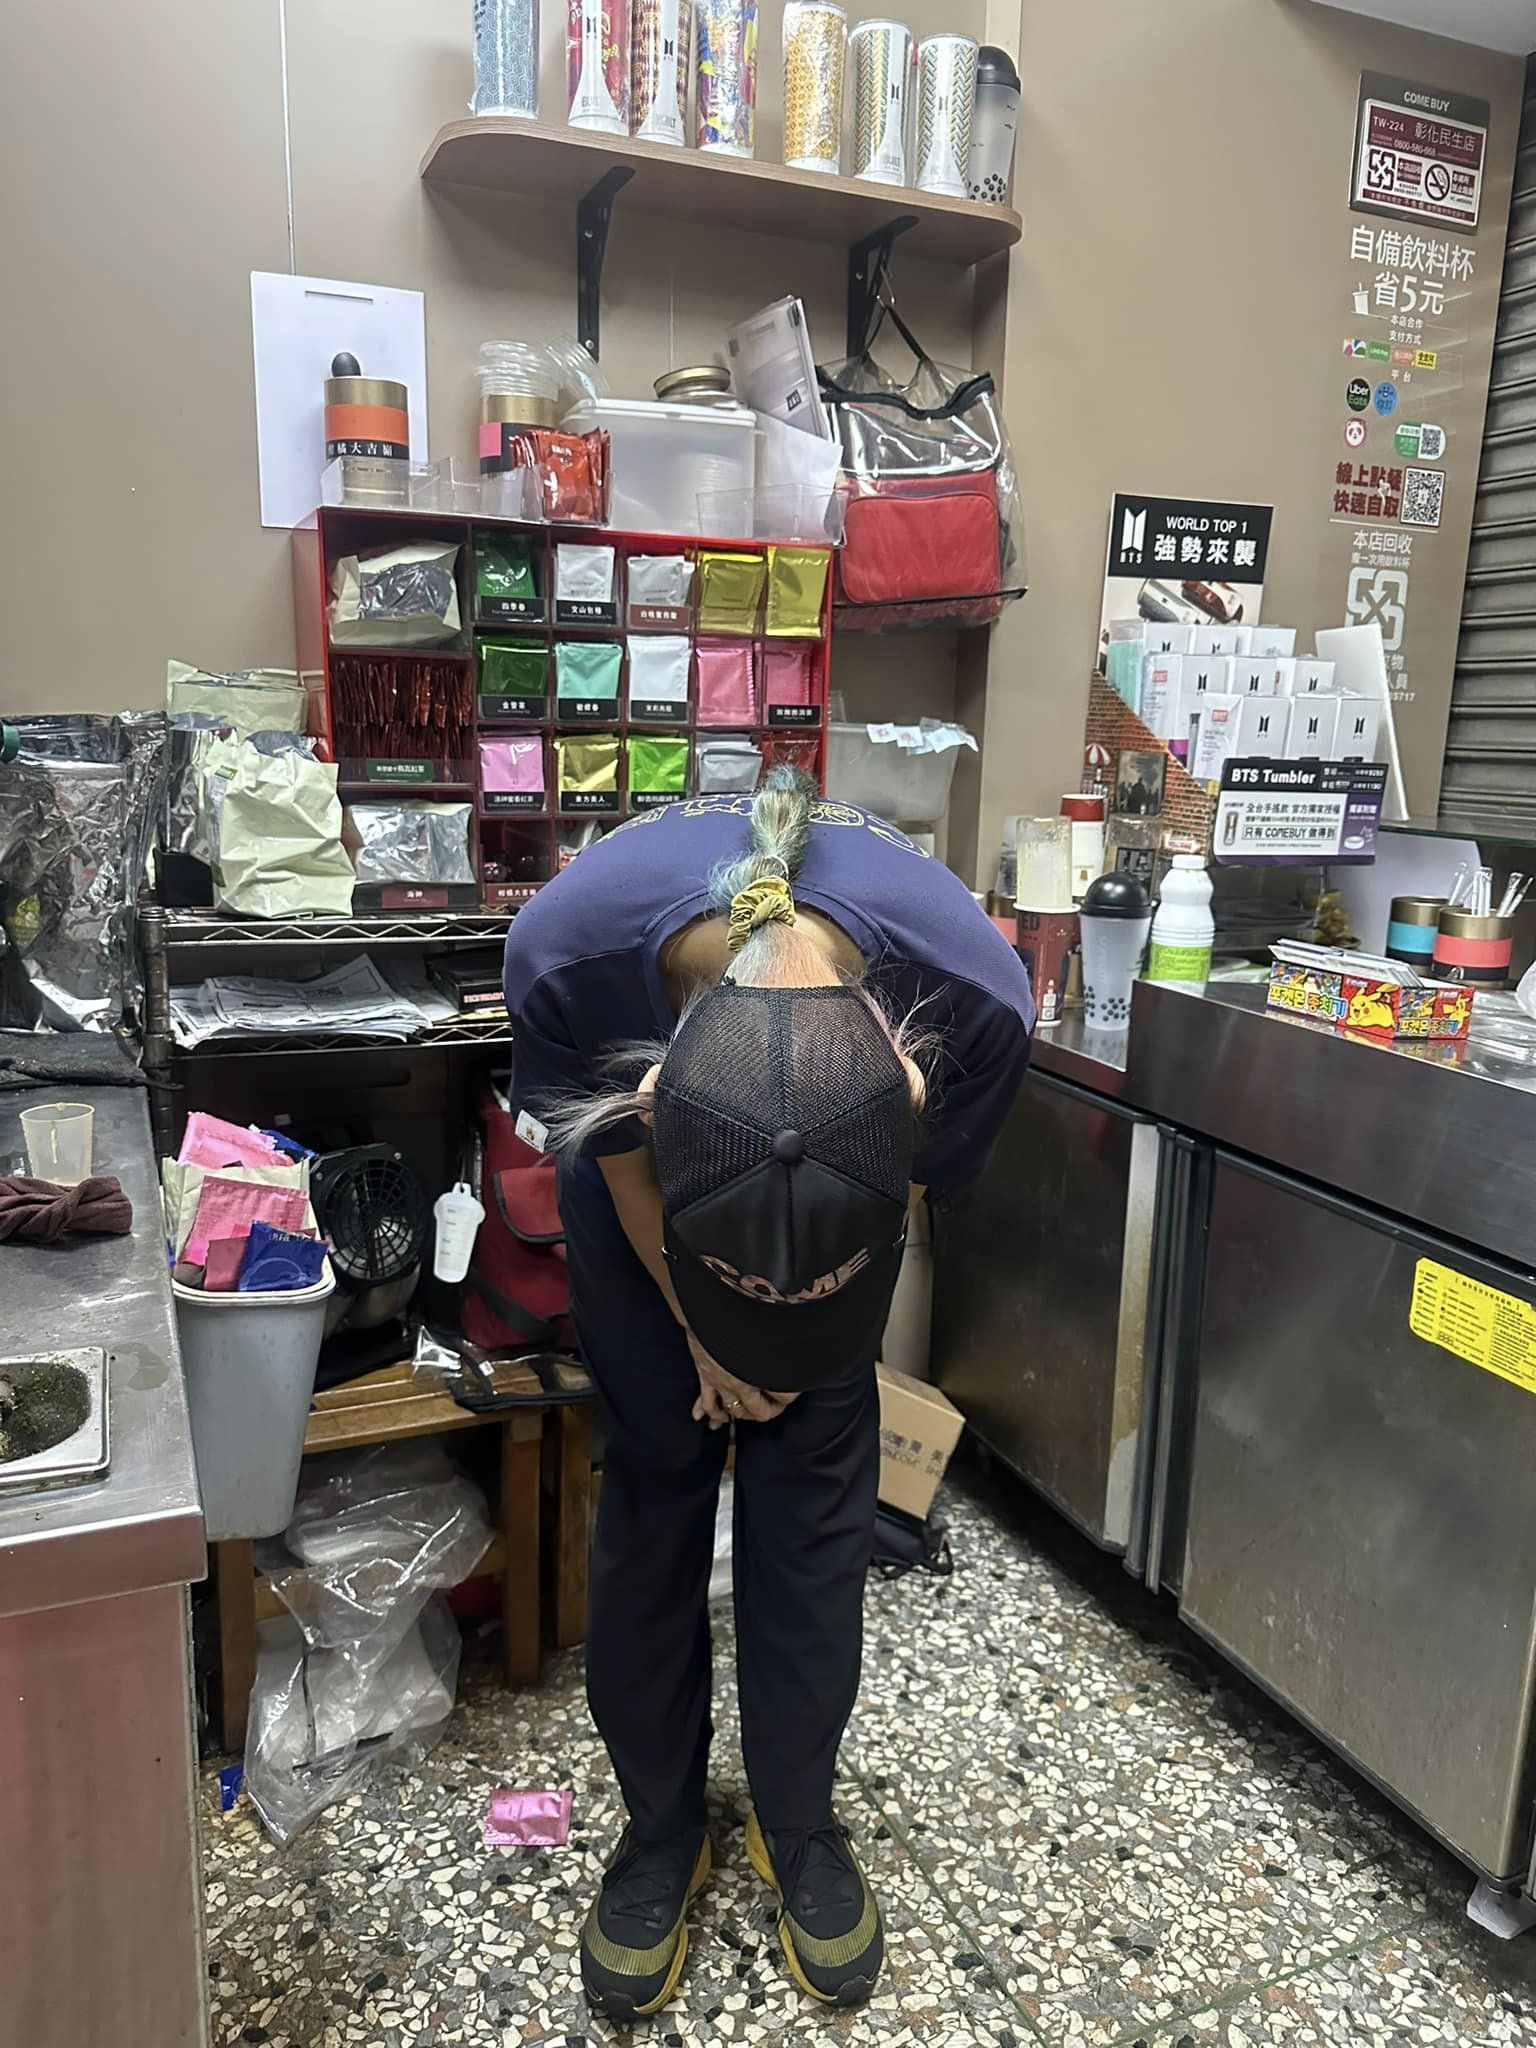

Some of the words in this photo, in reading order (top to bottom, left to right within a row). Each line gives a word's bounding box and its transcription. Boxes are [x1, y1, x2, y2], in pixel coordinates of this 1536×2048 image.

[1403, 91, 1450, 112] COMEBUY
[1415, 122, 1476, 151] 彰化民生店
[1350, 224, 1476, 282] 自備飲料杯
[1374, 271, 1445, 315] 省5元
[1390, 315, 1424, 329] 本店合作
[1388, 330, 1421, 345] 支付方式
[1349, 383, 1369, 395] Uber
[1336, 462, 1402, 492] 線上點餐
[1334, 489, 1399, 518] 快速自取
[1166, 515, 1210, 532] WORLD
[1212, 518, 1238, 533] TOP
[1240, 520, 1248, 534] 1
[1154, 533, 1257, 567] 強勢來襲
[1353, 529, 1413, 555] 本店回收
[1119, 551, 1143, 564] BTS
[1231, 767, 1259, 784] BTS
[1262, 768, 1317, 785] Tumbler
[1244, 826, 1263, 838] 只有
[1265, 827, 1308, 839] COMEBUY
[1270, 984, 1306, 1008] 포켓몬
[1307, 991, 1348, 1018] 종치기
[1400, 1018, 1429, 1036] 포켓몬
